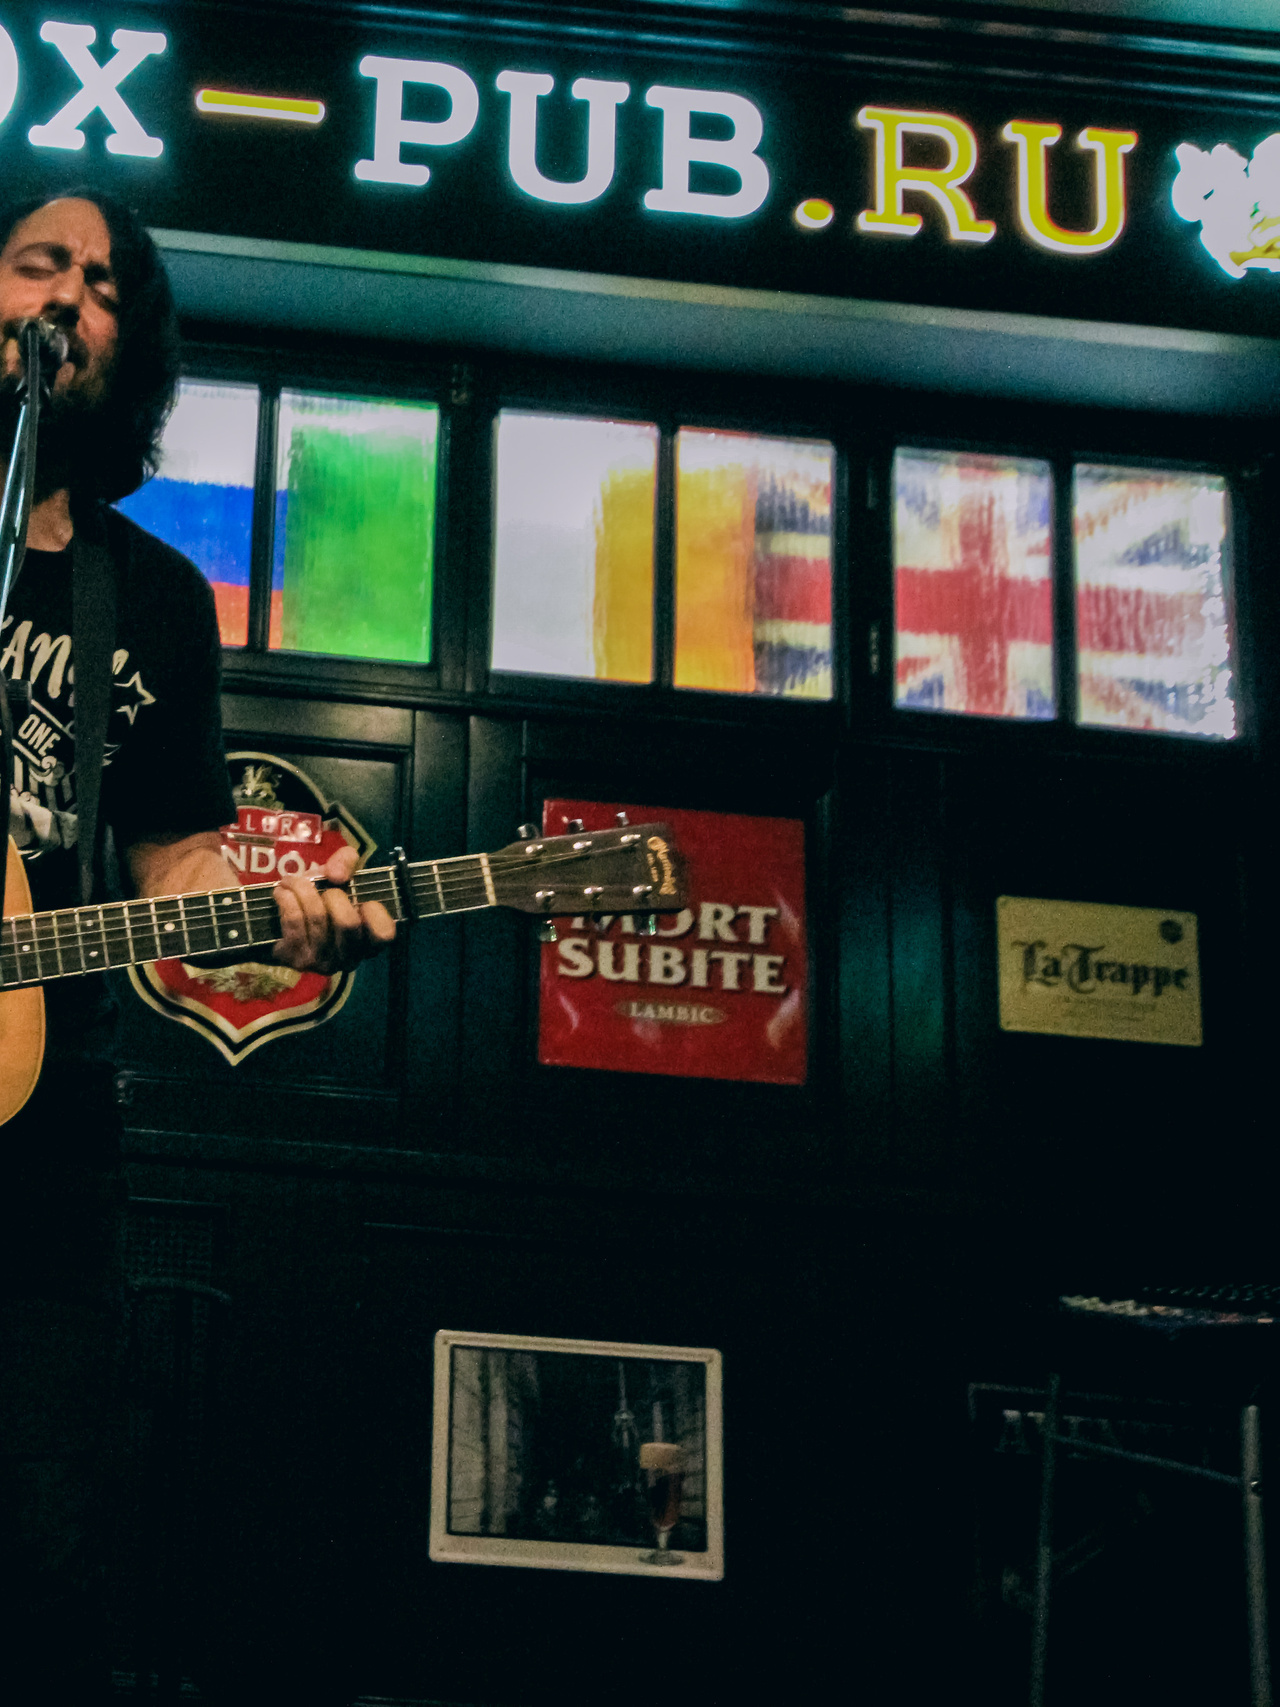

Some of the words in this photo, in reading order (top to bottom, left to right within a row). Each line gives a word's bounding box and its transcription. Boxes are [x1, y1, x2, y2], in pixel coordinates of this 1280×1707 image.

[19, 713, 61, 758] ONE
[220, 843, 329, 878] NDO
[557, 937, 788, 994] SUBITE
[1011, 940, 1061, 987] La
[1062, 943, 1189, 997] Trappe
[628, 1001, 714, 1021] LAMBIC
